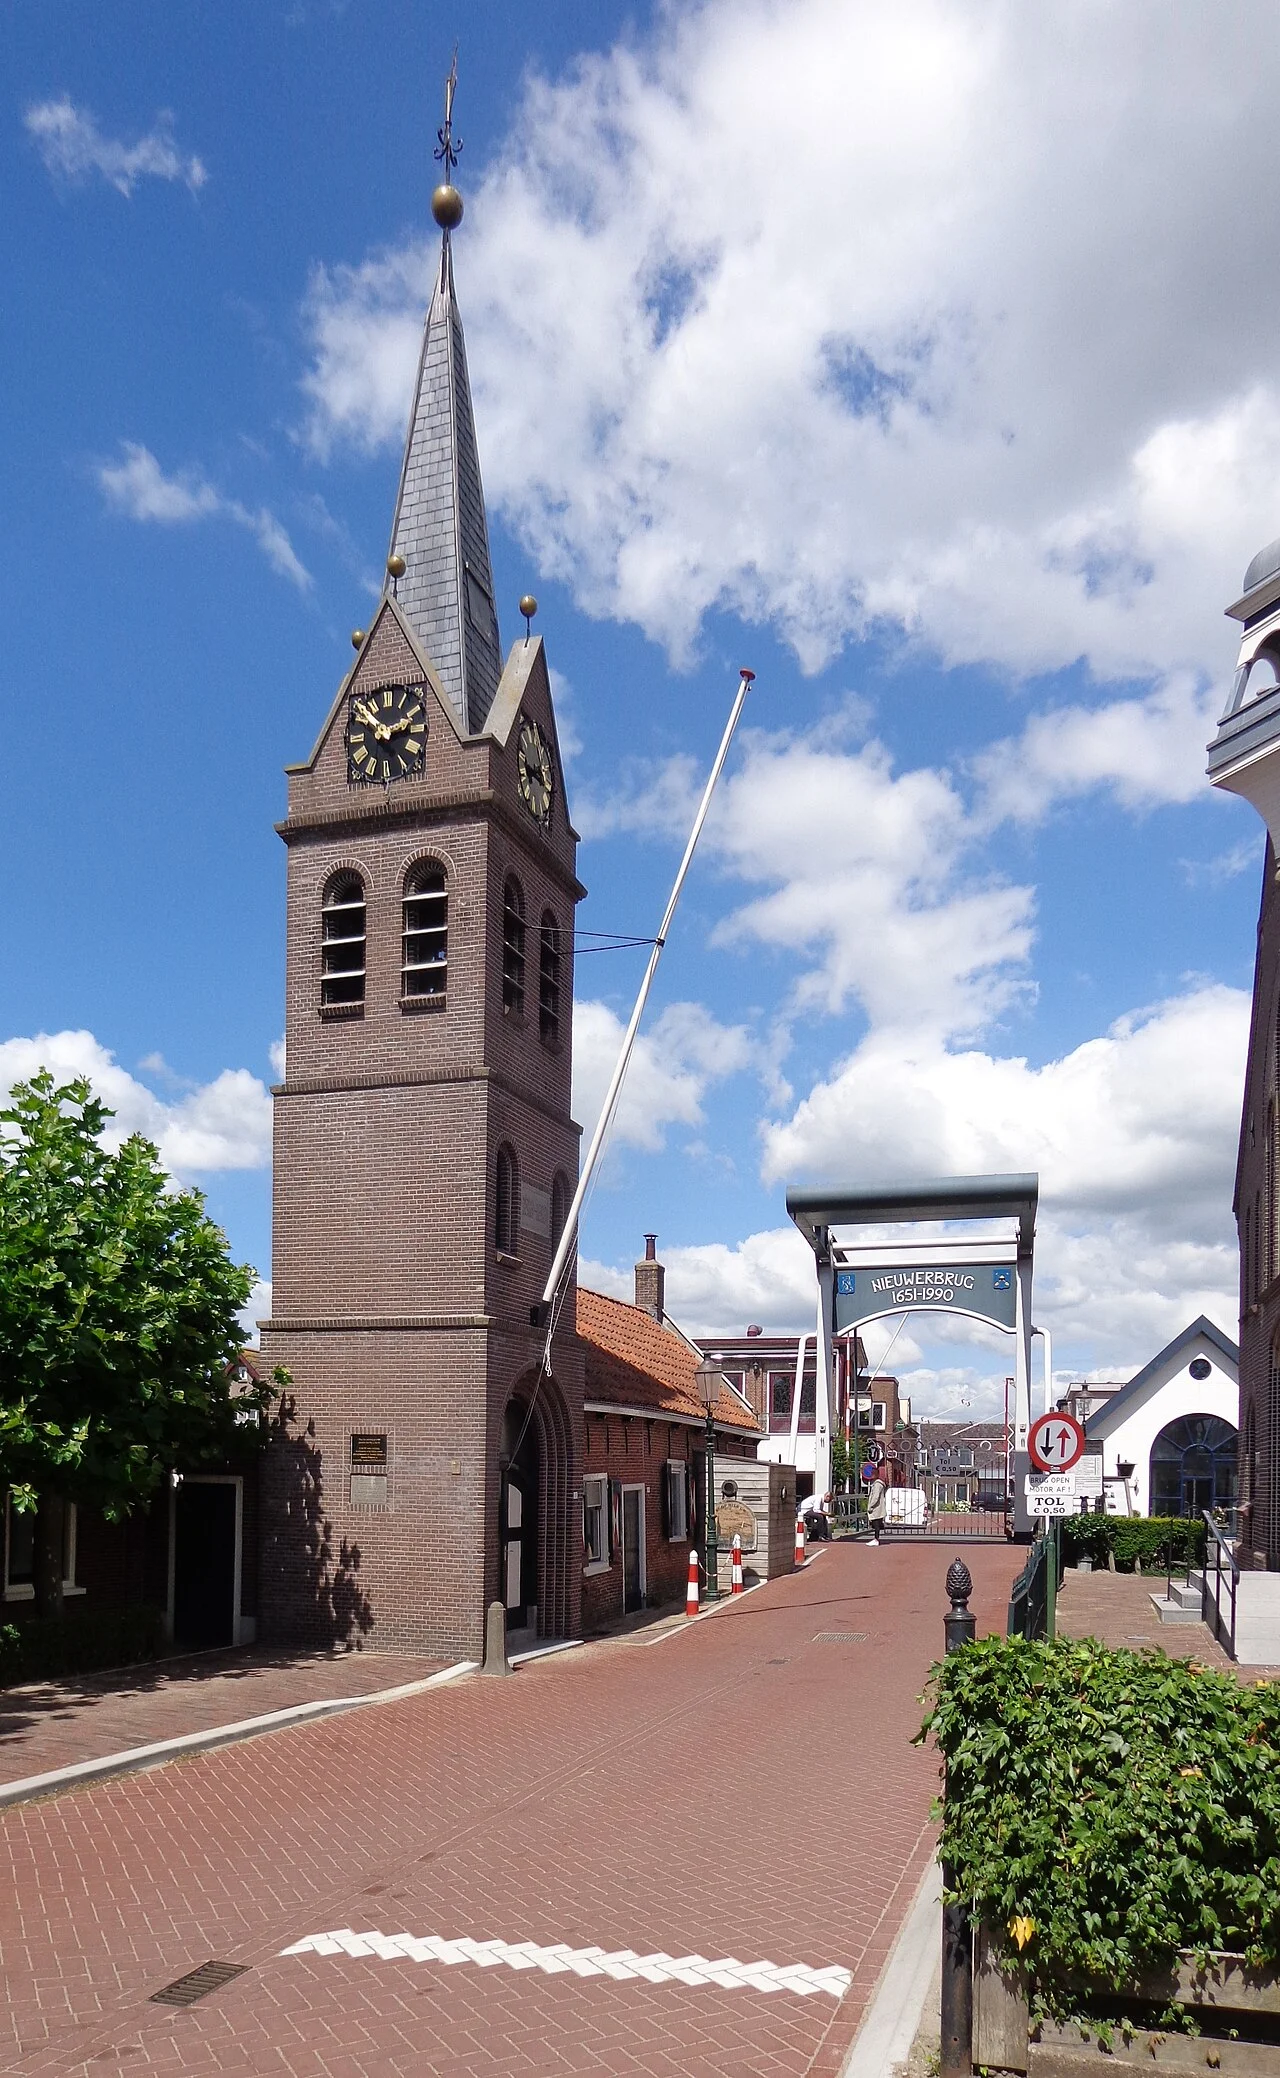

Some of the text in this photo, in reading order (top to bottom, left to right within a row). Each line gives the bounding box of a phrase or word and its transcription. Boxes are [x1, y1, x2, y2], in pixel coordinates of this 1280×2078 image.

[871, 1271, 975, 1293] NIEUWERBRUG
[891, 1287, 954, 1304] 1651-1990
[1034, 1497, 1065, 1506] TOL
